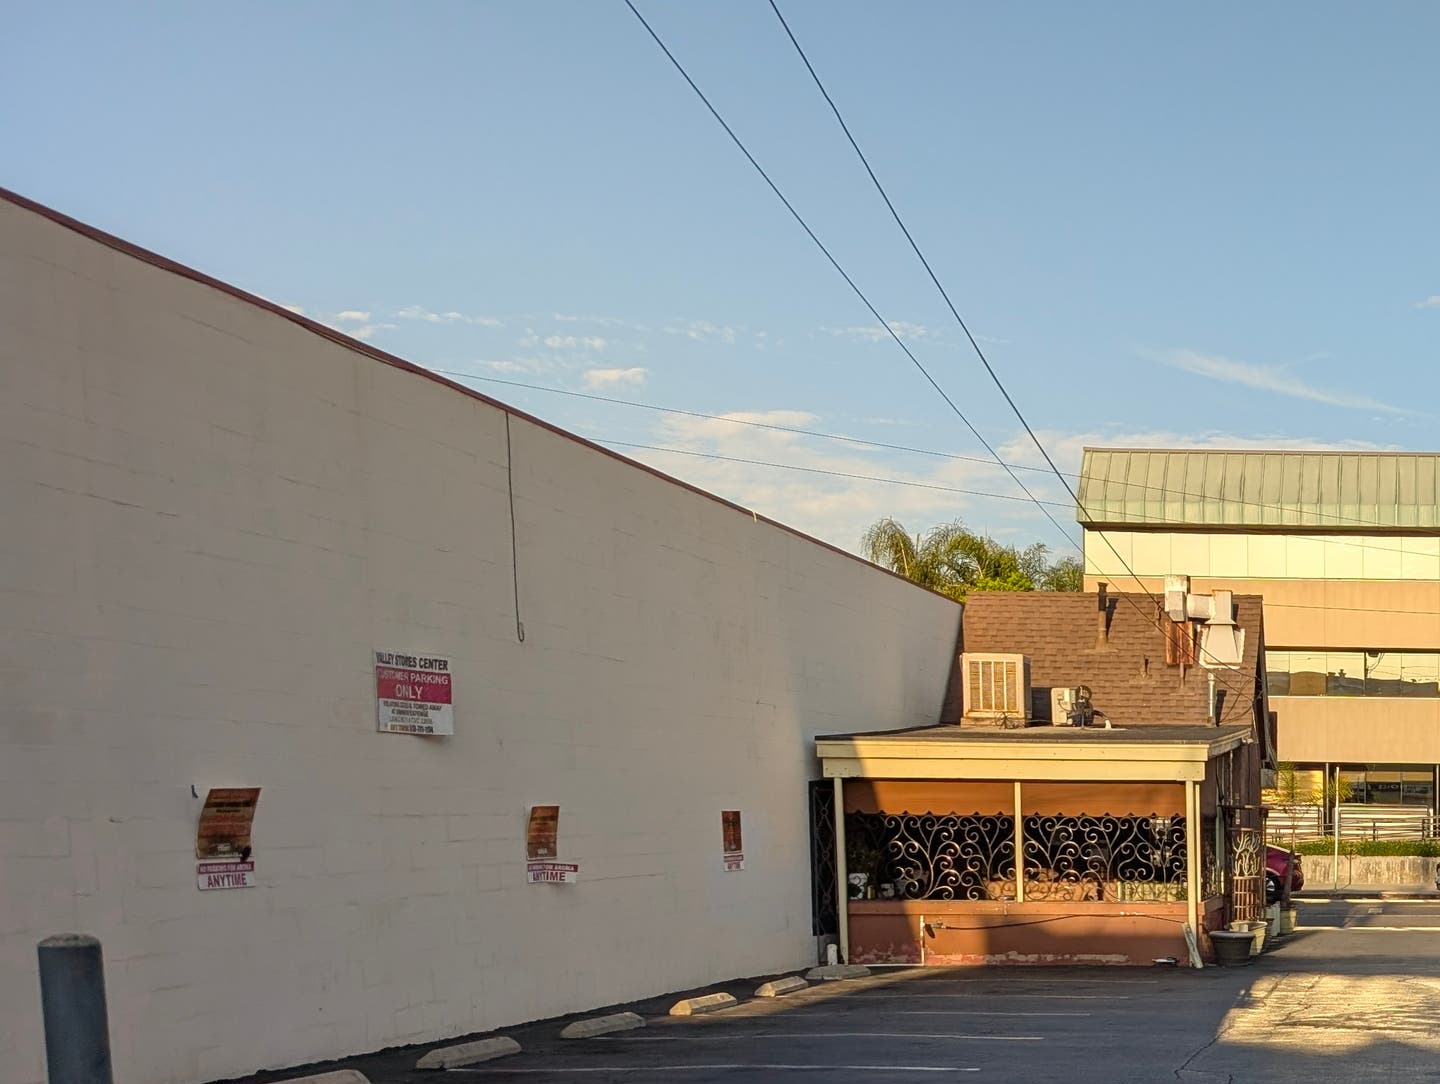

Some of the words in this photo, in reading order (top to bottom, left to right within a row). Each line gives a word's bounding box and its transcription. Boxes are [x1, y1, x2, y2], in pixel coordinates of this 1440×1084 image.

[395, 654, 418, 668] STORES
[418, 657, 448, 671] CENTER
[410, 672, 449, 685] PARKING
[395, 683, 424, 700] ONLY
[207, 873, 248, 888] ANYTIME
